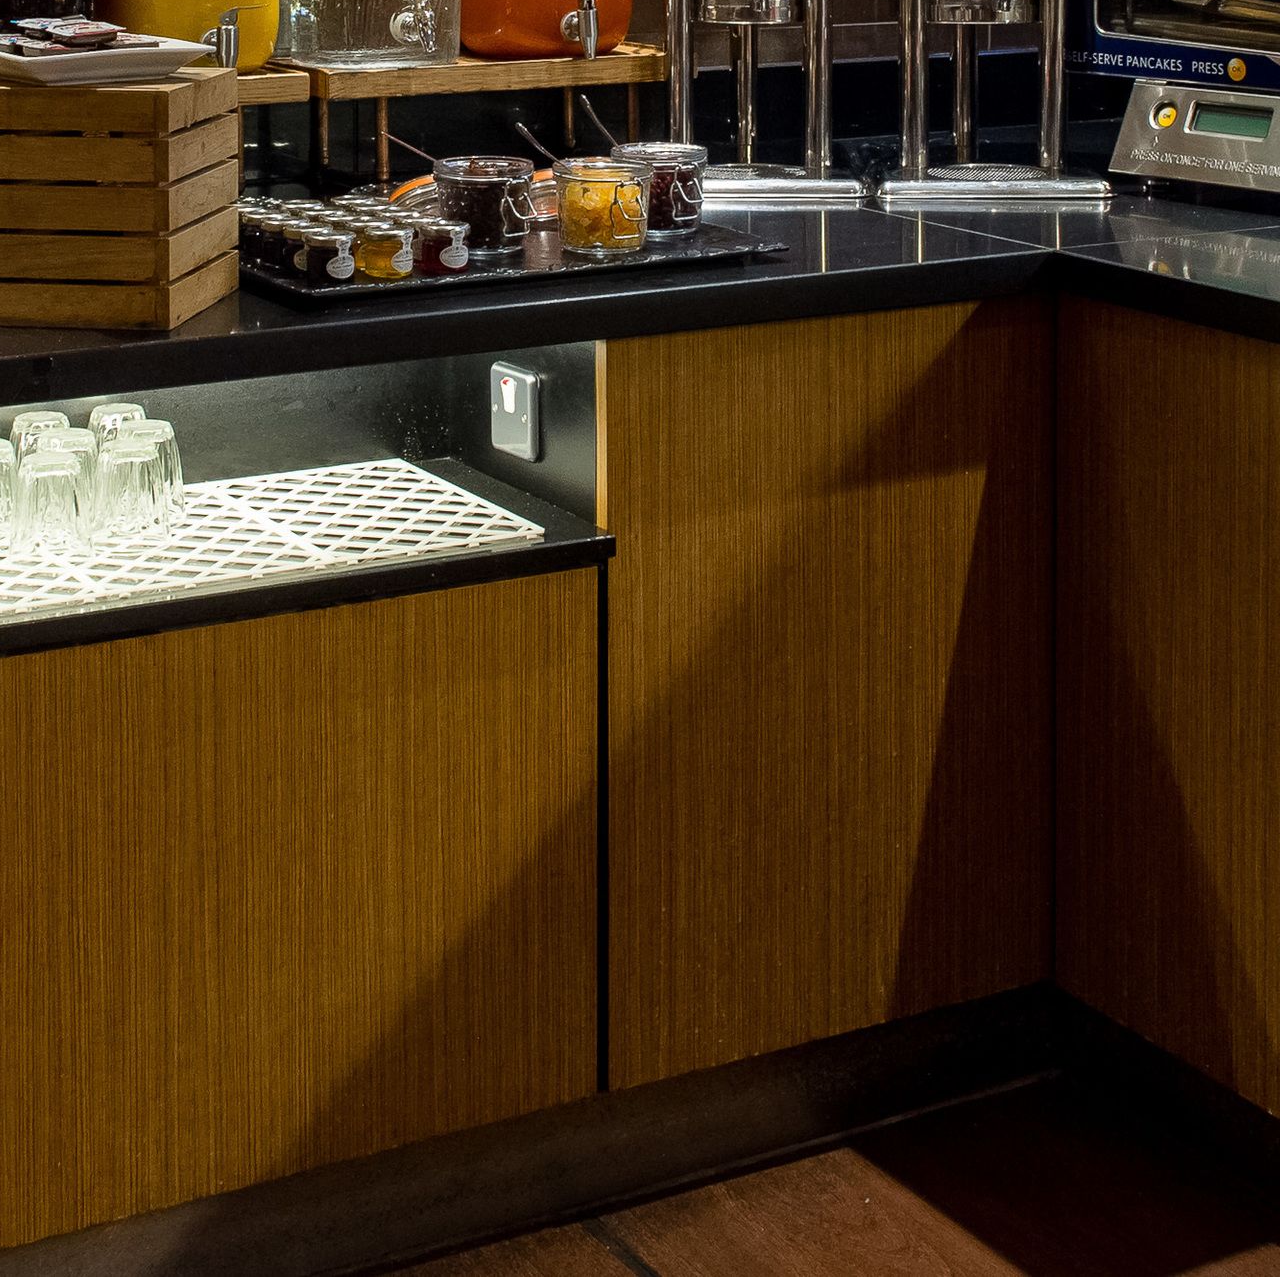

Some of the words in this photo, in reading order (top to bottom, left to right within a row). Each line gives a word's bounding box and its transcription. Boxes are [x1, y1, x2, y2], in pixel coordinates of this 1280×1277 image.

[1126, 55, 1183, 72] PANCAKES
[1191, 60, 1224, 75] PRESS
[1130, 149, 1160, 162] PRESS
[1204, 158, 1224, 171] FOR
[1224, 161, 1245, 173] ONE
